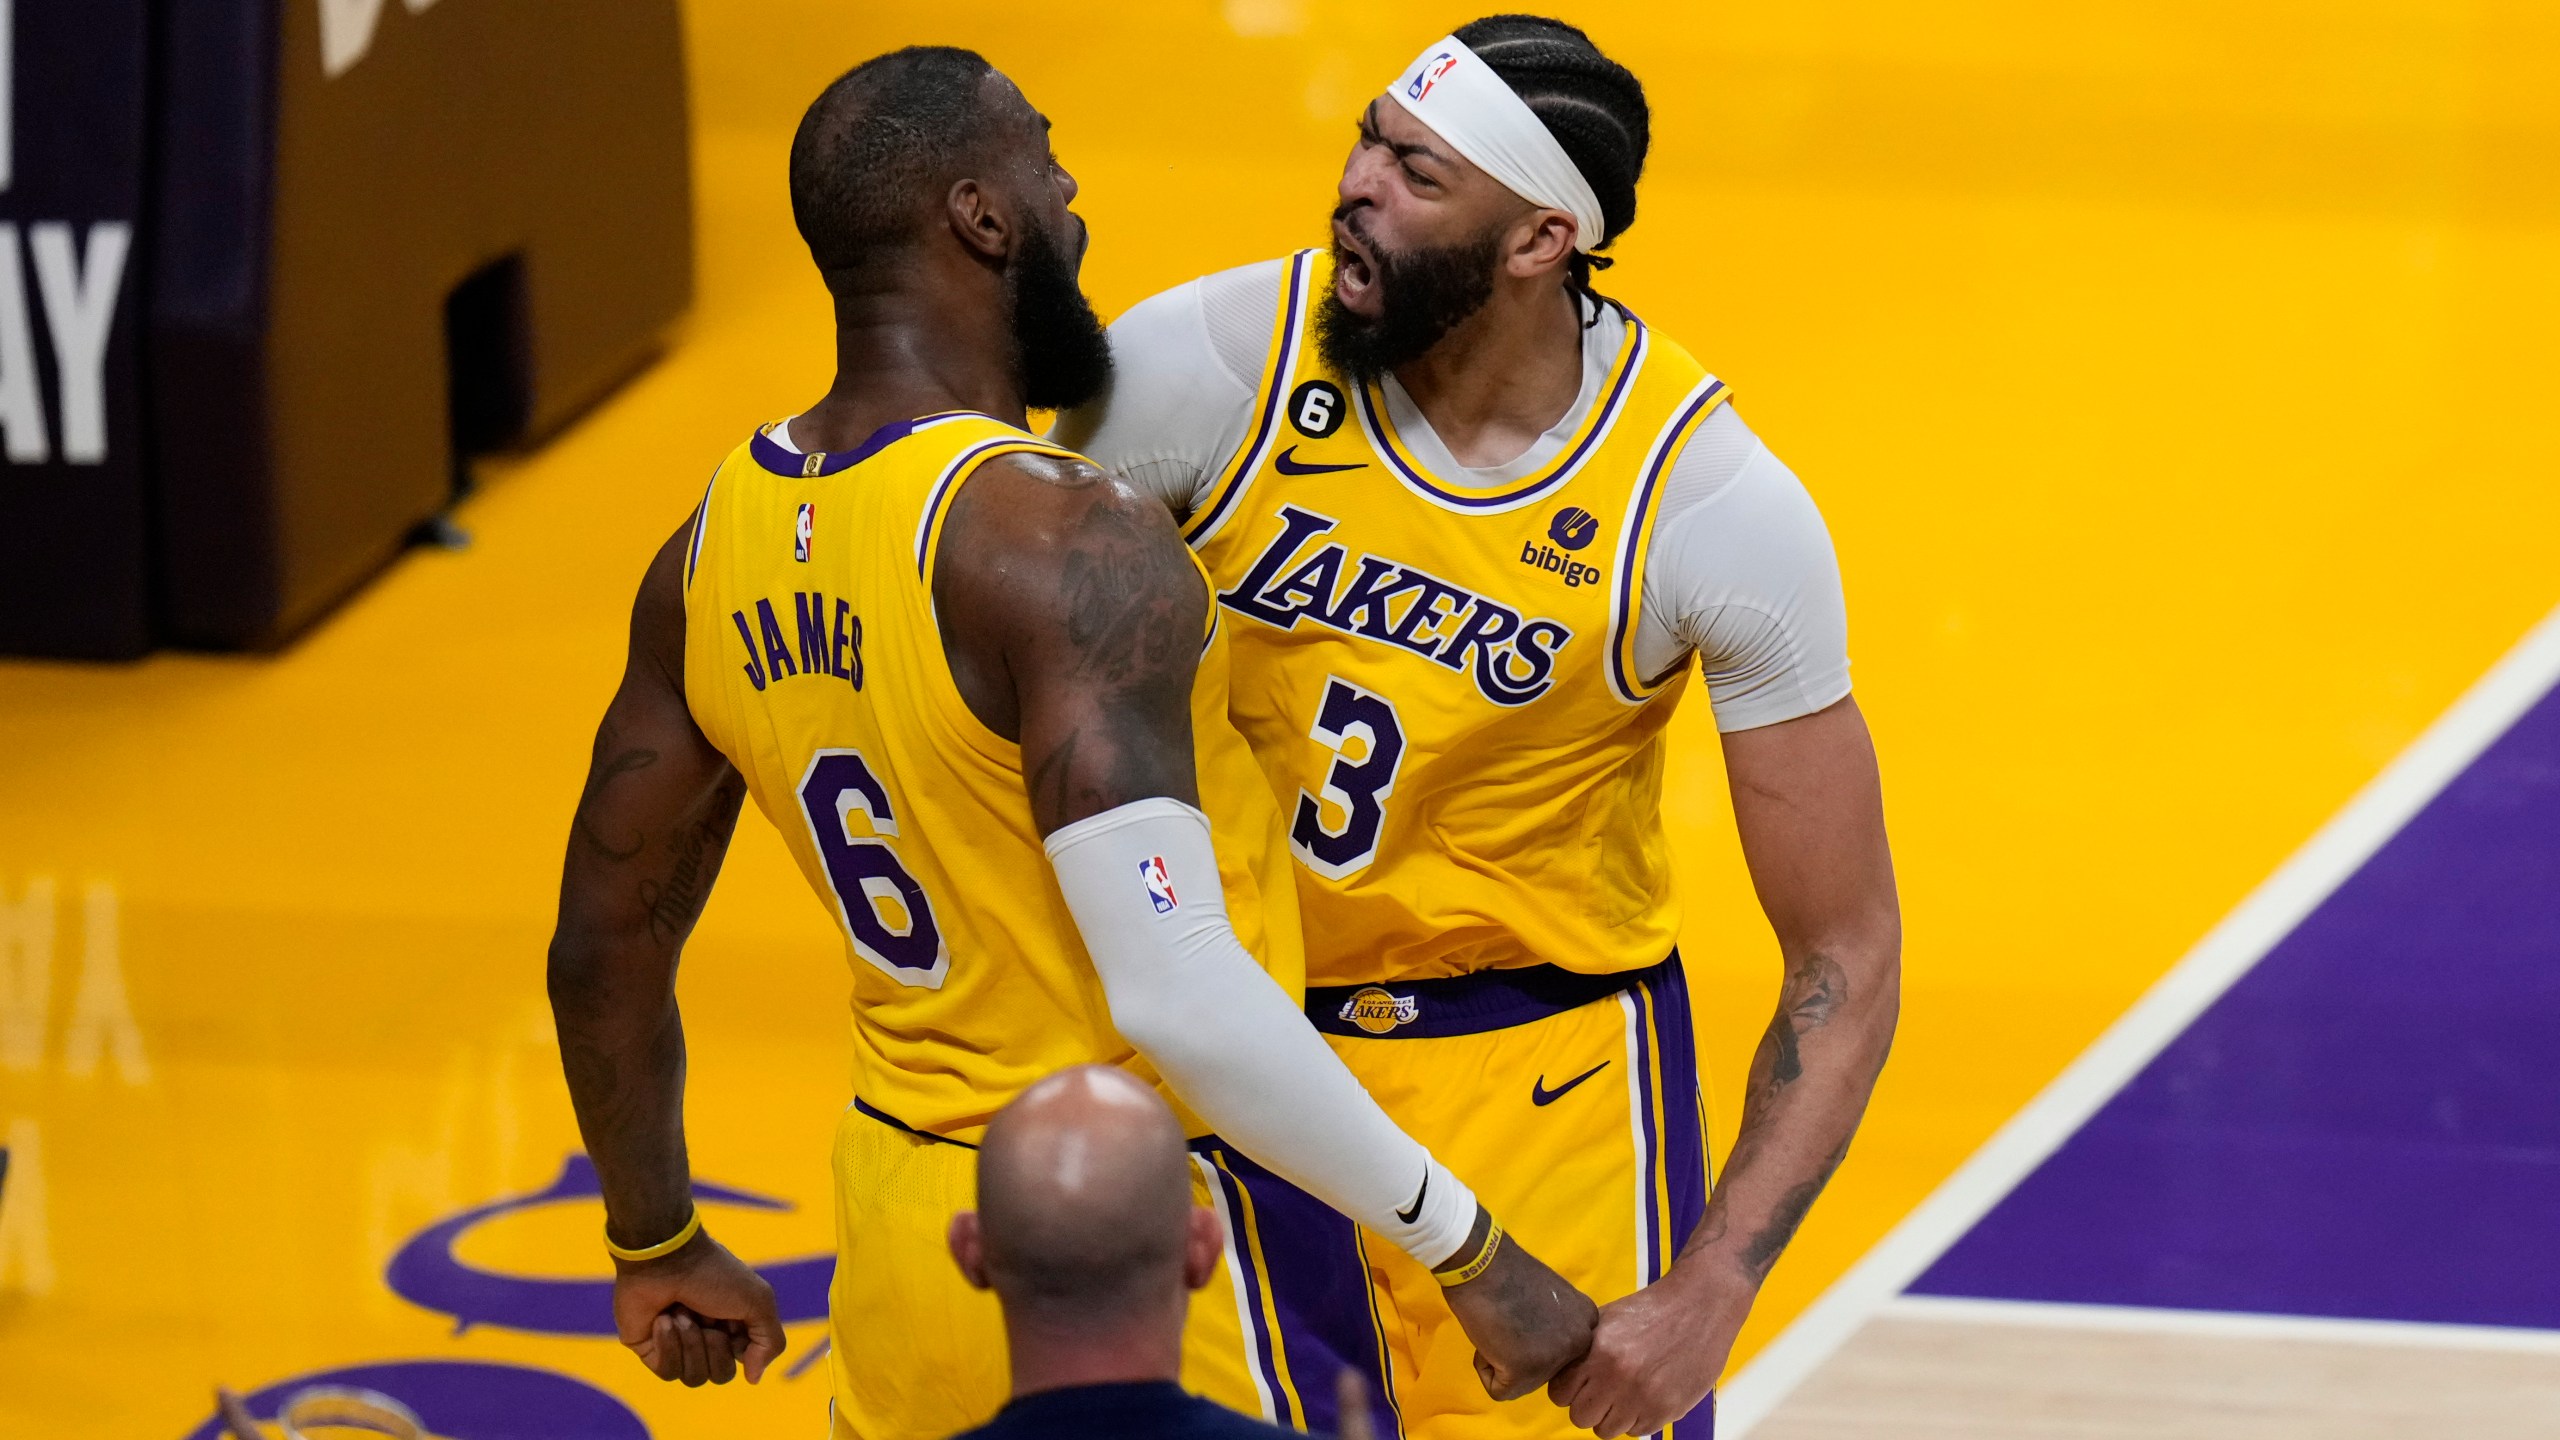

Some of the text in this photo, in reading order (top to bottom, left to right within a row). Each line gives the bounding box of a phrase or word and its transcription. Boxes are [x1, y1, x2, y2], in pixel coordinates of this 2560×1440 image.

[1299, 387, 1334, 432] 6
[1520, 541, 1600, 588] bibigo
[1217, 502, 1574, 707] LAKERS
[732, 592, 864, 693] JAMES
[1289, 673, 1408, 882] 3
[796, 748, 950, 990] 6
[1341, 997, 1416, 1023] LAKERS
[1459, 1231, 1499, 1280] PROMISE
